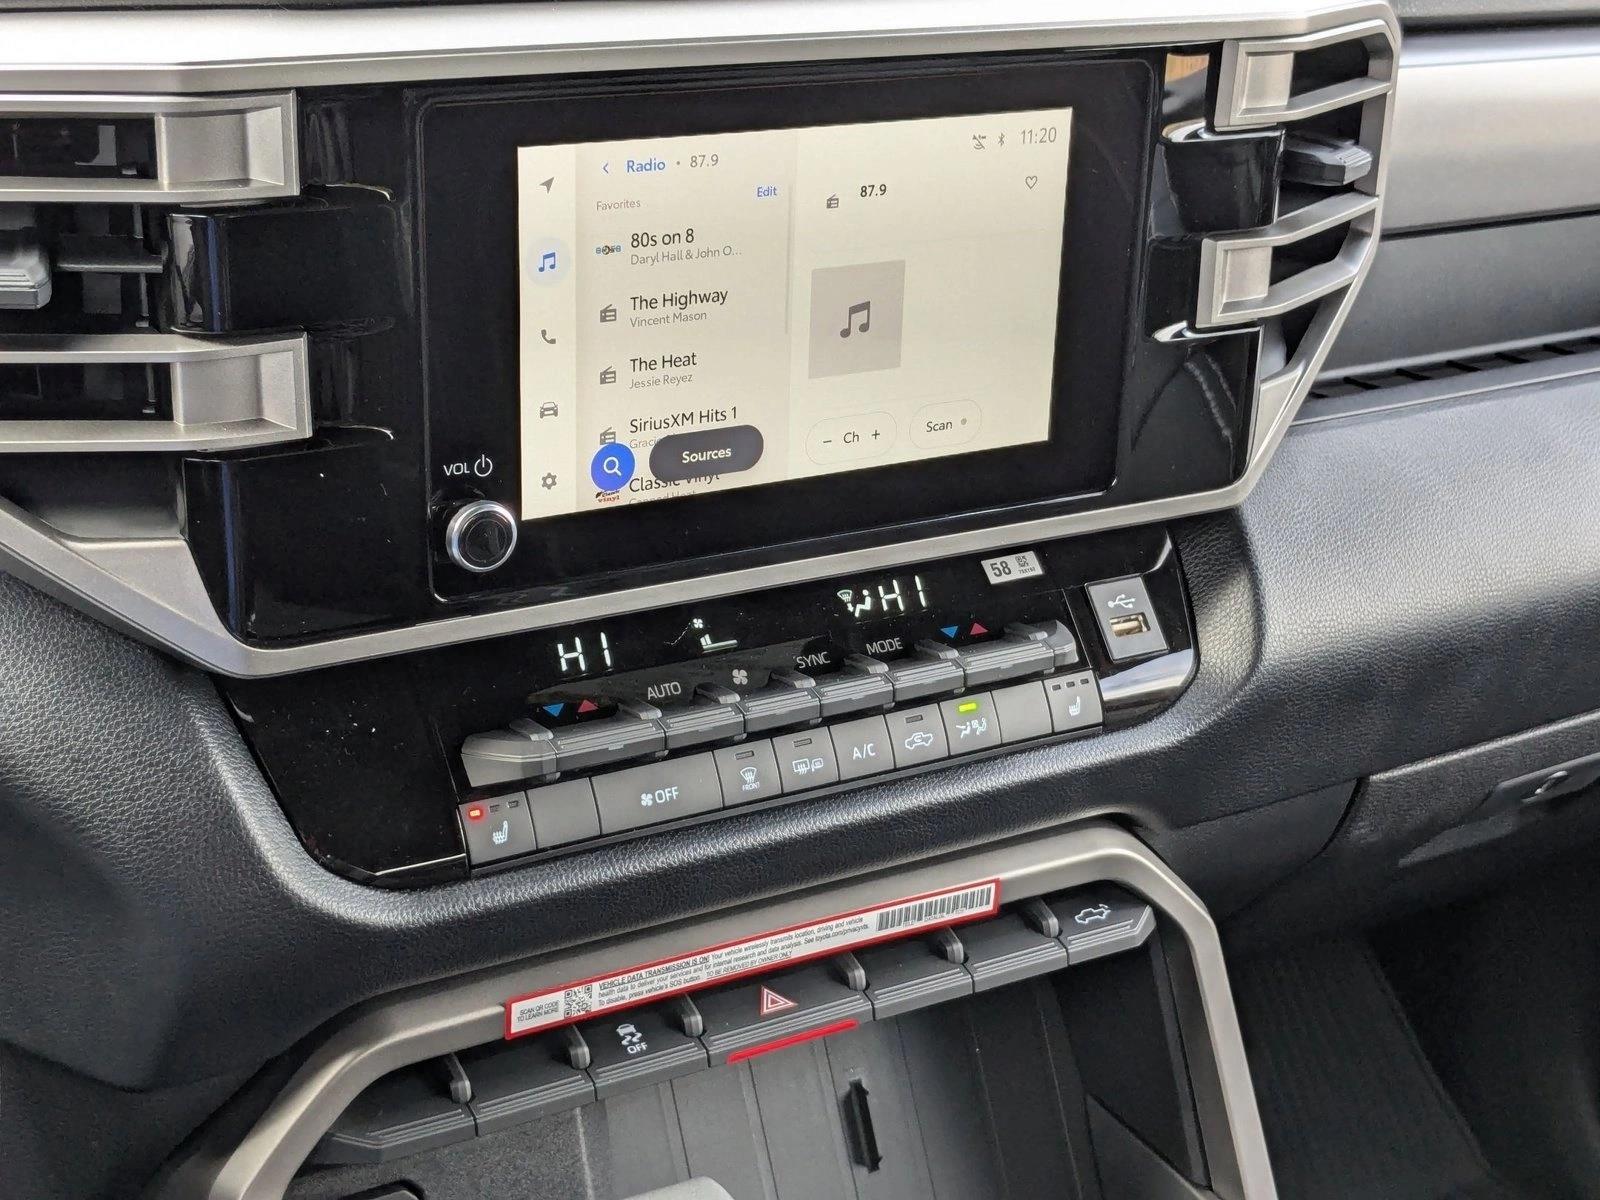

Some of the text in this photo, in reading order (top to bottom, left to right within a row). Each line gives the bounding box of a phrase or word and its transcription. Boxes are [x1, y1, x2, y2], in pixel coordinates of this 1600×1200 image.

[1020, 126, 1057, 145] 11:20
[626, 153, 719, 173] Radio 87.9
[757, 186, 778, 198] Edit
[860, 184, 887, 197] 87.9
[596, 198, 641, 211] Favorites
[630, 228, 695, 249] 80s on 8
[630, 252, 659, 266] Daryl
[661, 250, 684, 263] Hall
[685, 250, 693, 260] &
[694, 247, 720, 260] John
[630, 289, 729, 312] The Highway
[630, 311, 707, 328] Vincent Mason
[630, 352, 697, 373] The Heat
[629, 373, 693, 390] Jessie Reyez
[629, 406, 738, 434] SiriusXM Hits 1
[926, 420, 953, 433] Scan
[843, 432, 860, 444] Ch
[682, 448, 732, 464] Sources
[443, 463, 470, 476] VOL
[990, 560, 1012, 577] 58
[866, 637, 903, 655] MODE
[796, 651, 831, 669] SYNC
[647, 680, 682, 701] AUTO
[852, 742, 876, 759] A/C
[654, 786, 680, 804] OFF
[741, 781, 761, 792] FRONT
[598, 976, 625, 990] VEHICLE
[626, 972, 642, 983] DATA
[644, 959, 690, 978] TRANSMISSION
[691, 957, 698, 966] IS
[710, 951, 722, 960] Your
[724, 946, 742, 957] vehicle
[816, 923, 833, 934] driving
[834, 920, 844, 928] and
[845, 915, 863, 926] vehicle
[616, 984, 628, 993] data
[630, 982, 635, 990] to
[637, 977, 655, 988] deliver
[656, 974, 668, 984] your
[669, 968, 691, 979] services
[692, 965, 702, 973] and
[712, 957, 732, 968] internal
[733, 951, 756, 963] research
[757, 948, 767, 957] and
[768, 945, 779, 954] data
[804, 936, 814, 944] See
[628, 989, 643, 999] press
[669, 978, 682, 987] SOS
[706, 970, 713, 978] TO
[722, 961, 749, 973] REMOVED
[757, 953, 778, 964] OWNER
[779, 950, 792, 959] ONLY
[520, 1006, 534, 1015] SCAN
[525, 1010, 542, 1020] LEARN
[627, 1041, 648, 1054] OFF
